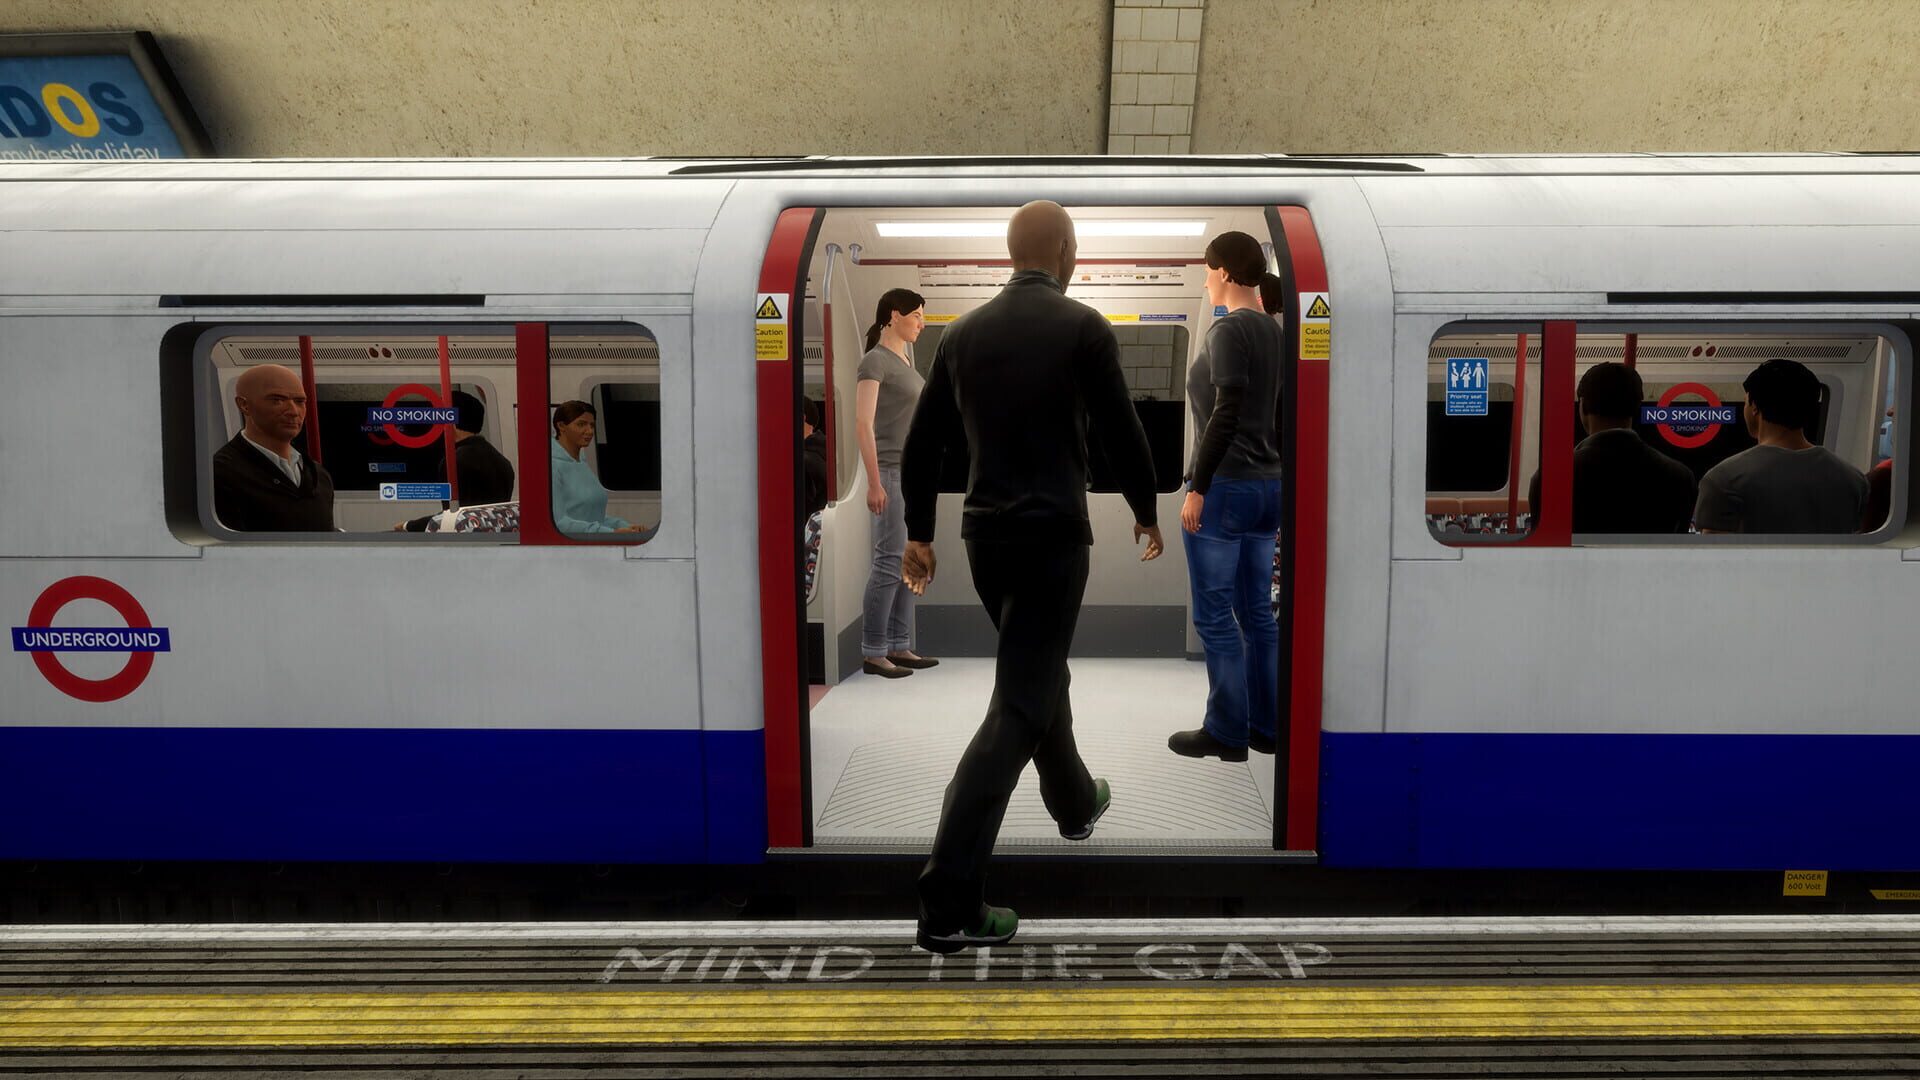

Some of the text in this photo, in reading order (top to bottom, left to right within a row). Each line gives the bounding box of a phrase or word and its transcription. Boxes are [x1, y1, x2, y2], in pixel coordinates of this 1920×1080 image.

[0, 82, 145, 138] DOS
[372, 410, 455, 421] NO SMOKING
[1646, 410, 1732, 421] NO SMOKING
[22, 632, 160, 647] UNDERGROUND
[1787, 873, 1824, 881] DANGER!
[598, 943, 1333, 983] MIND THE GAP
